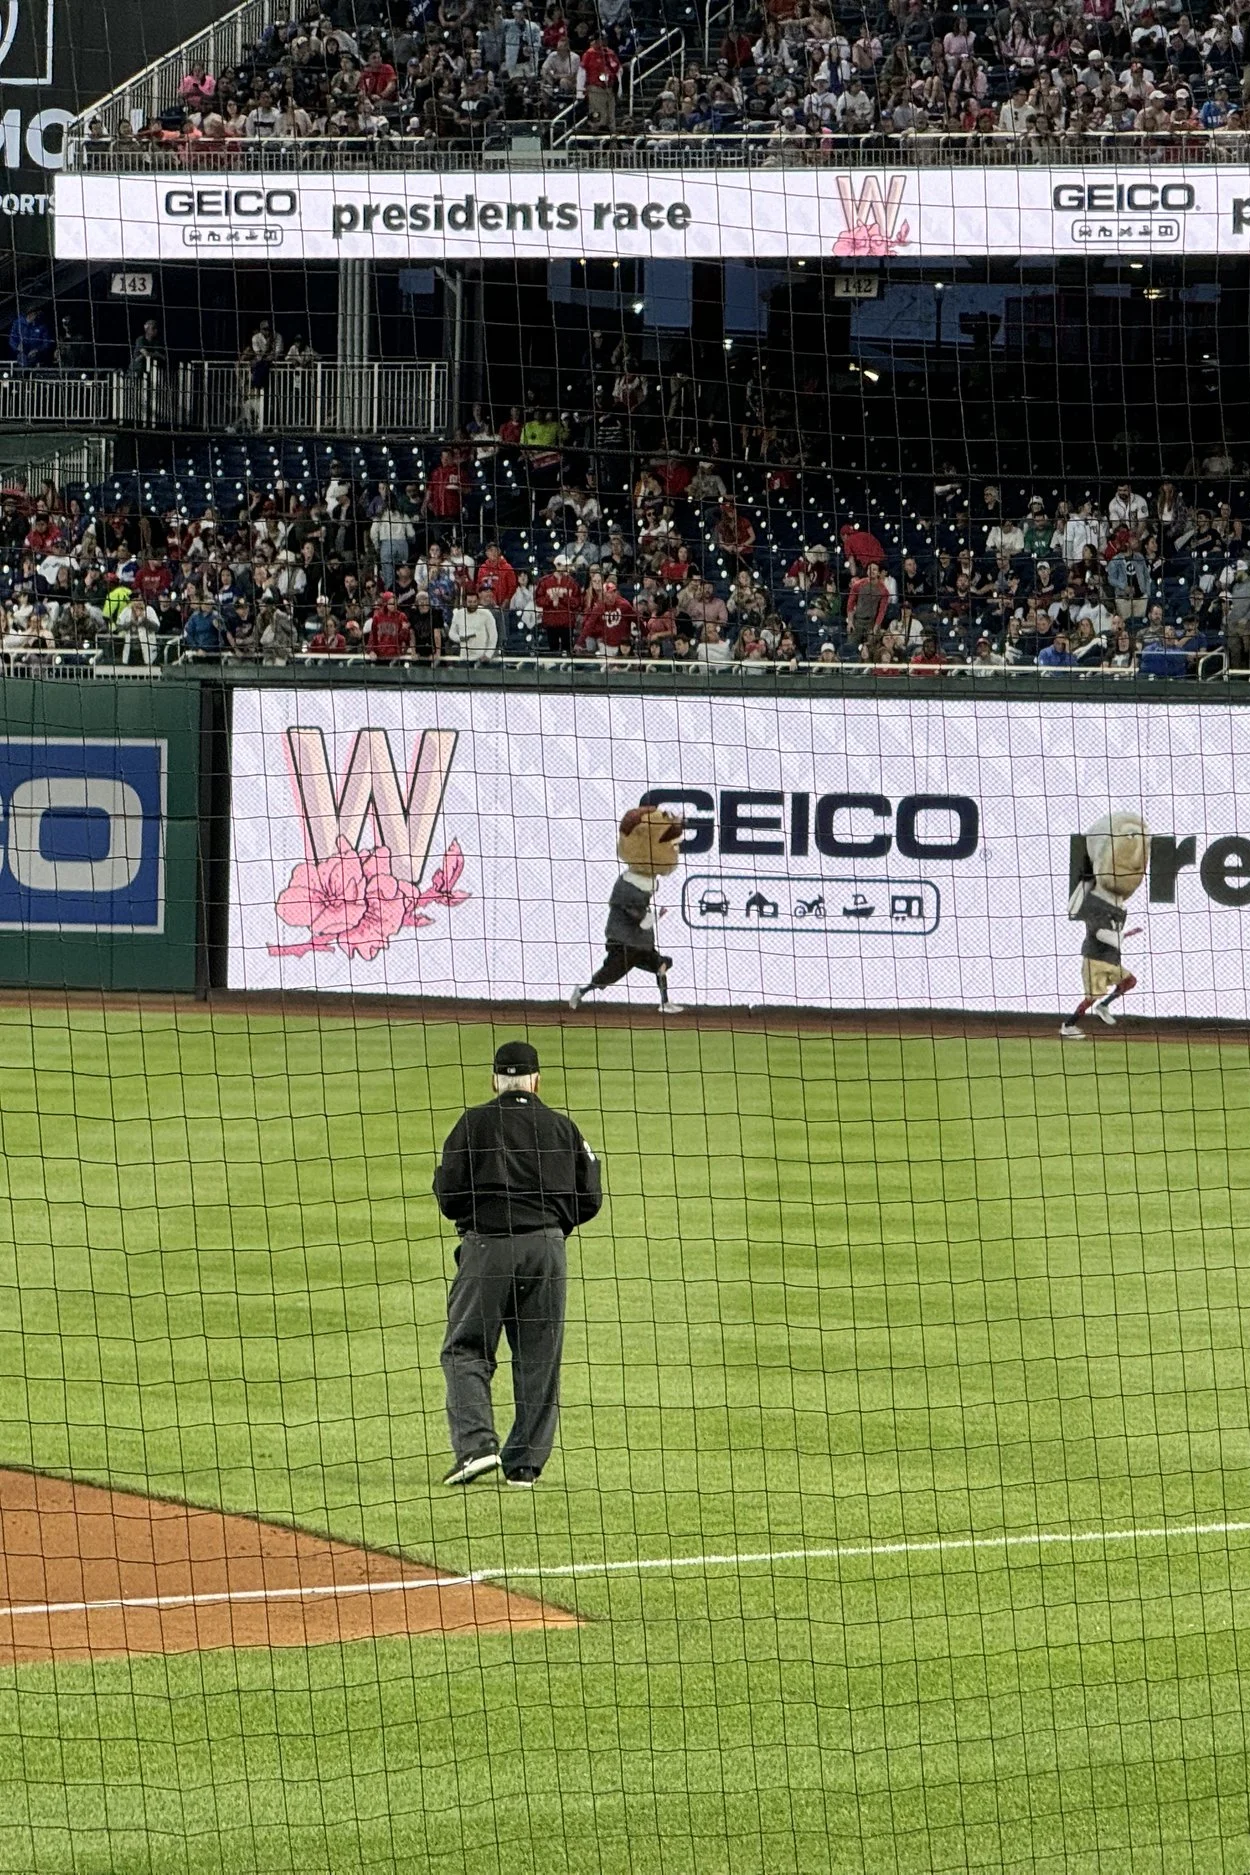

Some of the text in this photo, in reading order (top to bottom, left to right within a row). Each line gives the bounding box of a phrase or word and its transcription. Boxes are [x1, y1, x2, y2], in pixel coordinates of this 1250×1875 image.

[166, 190, 297, 217] GEICO
[1053, 184, 1195, 211] GEICO
[332, 195, 691, 239] presidents race
[120, 277, 148, 292] 143
[843, 278, 873, 294] 142
[638, 788, 980, 860] GEICO
